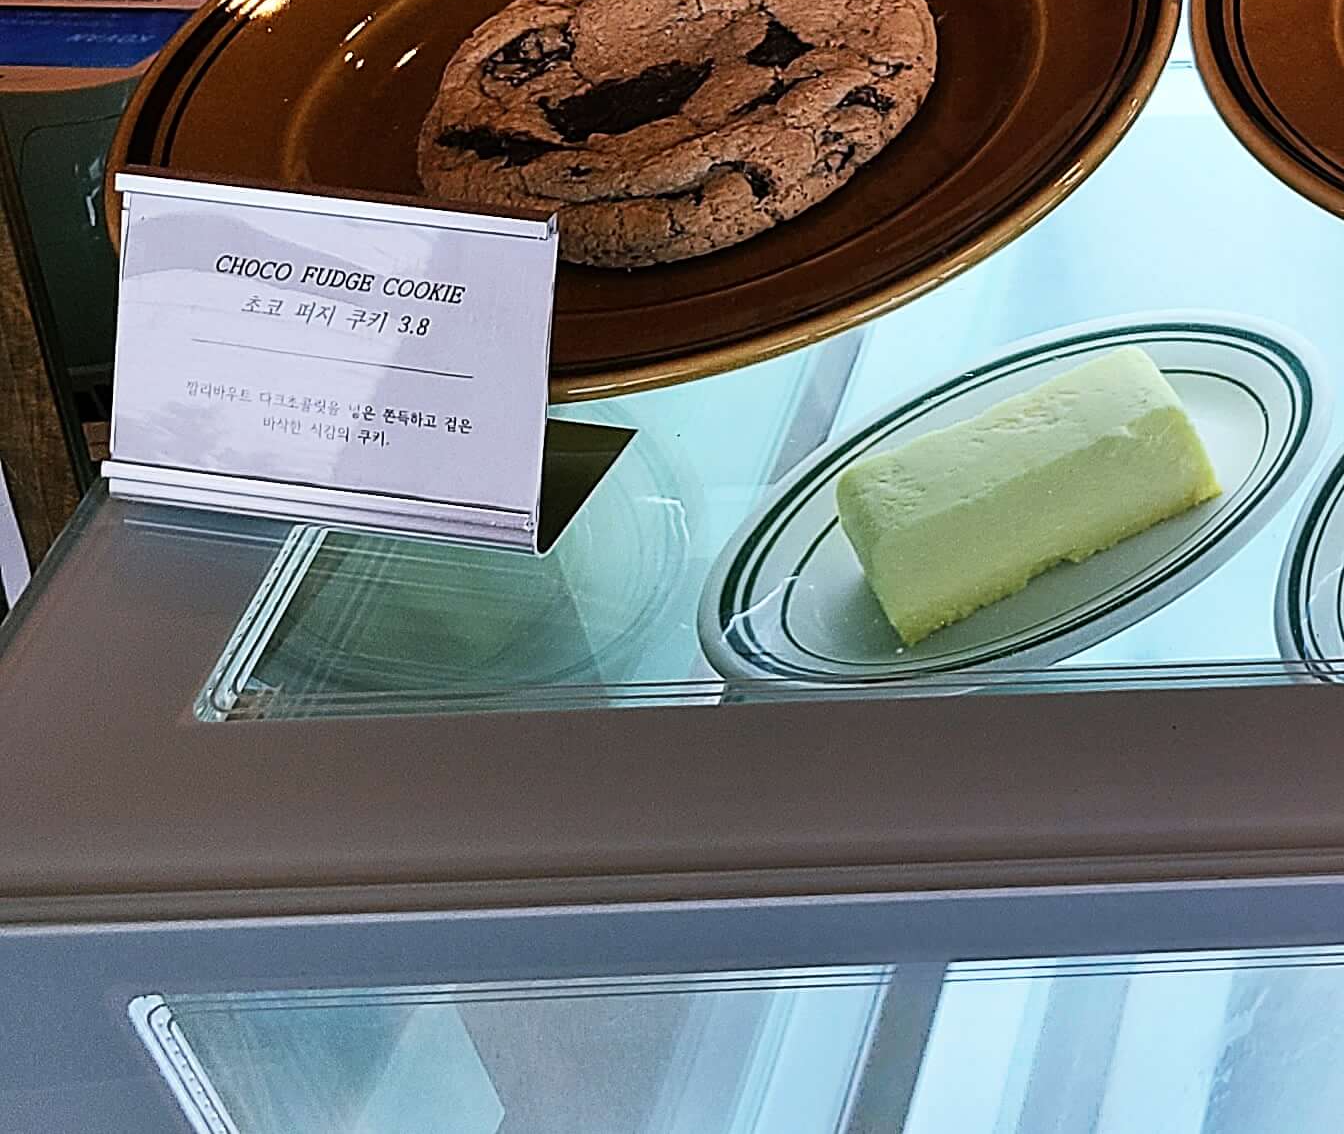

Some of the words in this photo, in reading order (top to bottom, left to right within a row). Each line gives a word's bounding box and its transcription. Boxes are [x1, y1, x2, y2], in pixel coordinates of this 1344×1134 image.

[216, 255, 292, 281] CHOCO
[300, 266, 375, 292] FUDGE
[383, 277, 466, 304] COOKIE
[241, 296, 284, 317] 초코
[296, 302, 336, 326] 퍼지
[346, 309, 388, 333] 쿠키
[397, 315, 430, 336] 3.8
[263, 416, 302, 435] 바삭한
[358, 429, 389, 447] 쿠키.
[383, 408, 437, 428] 쫀득하고
